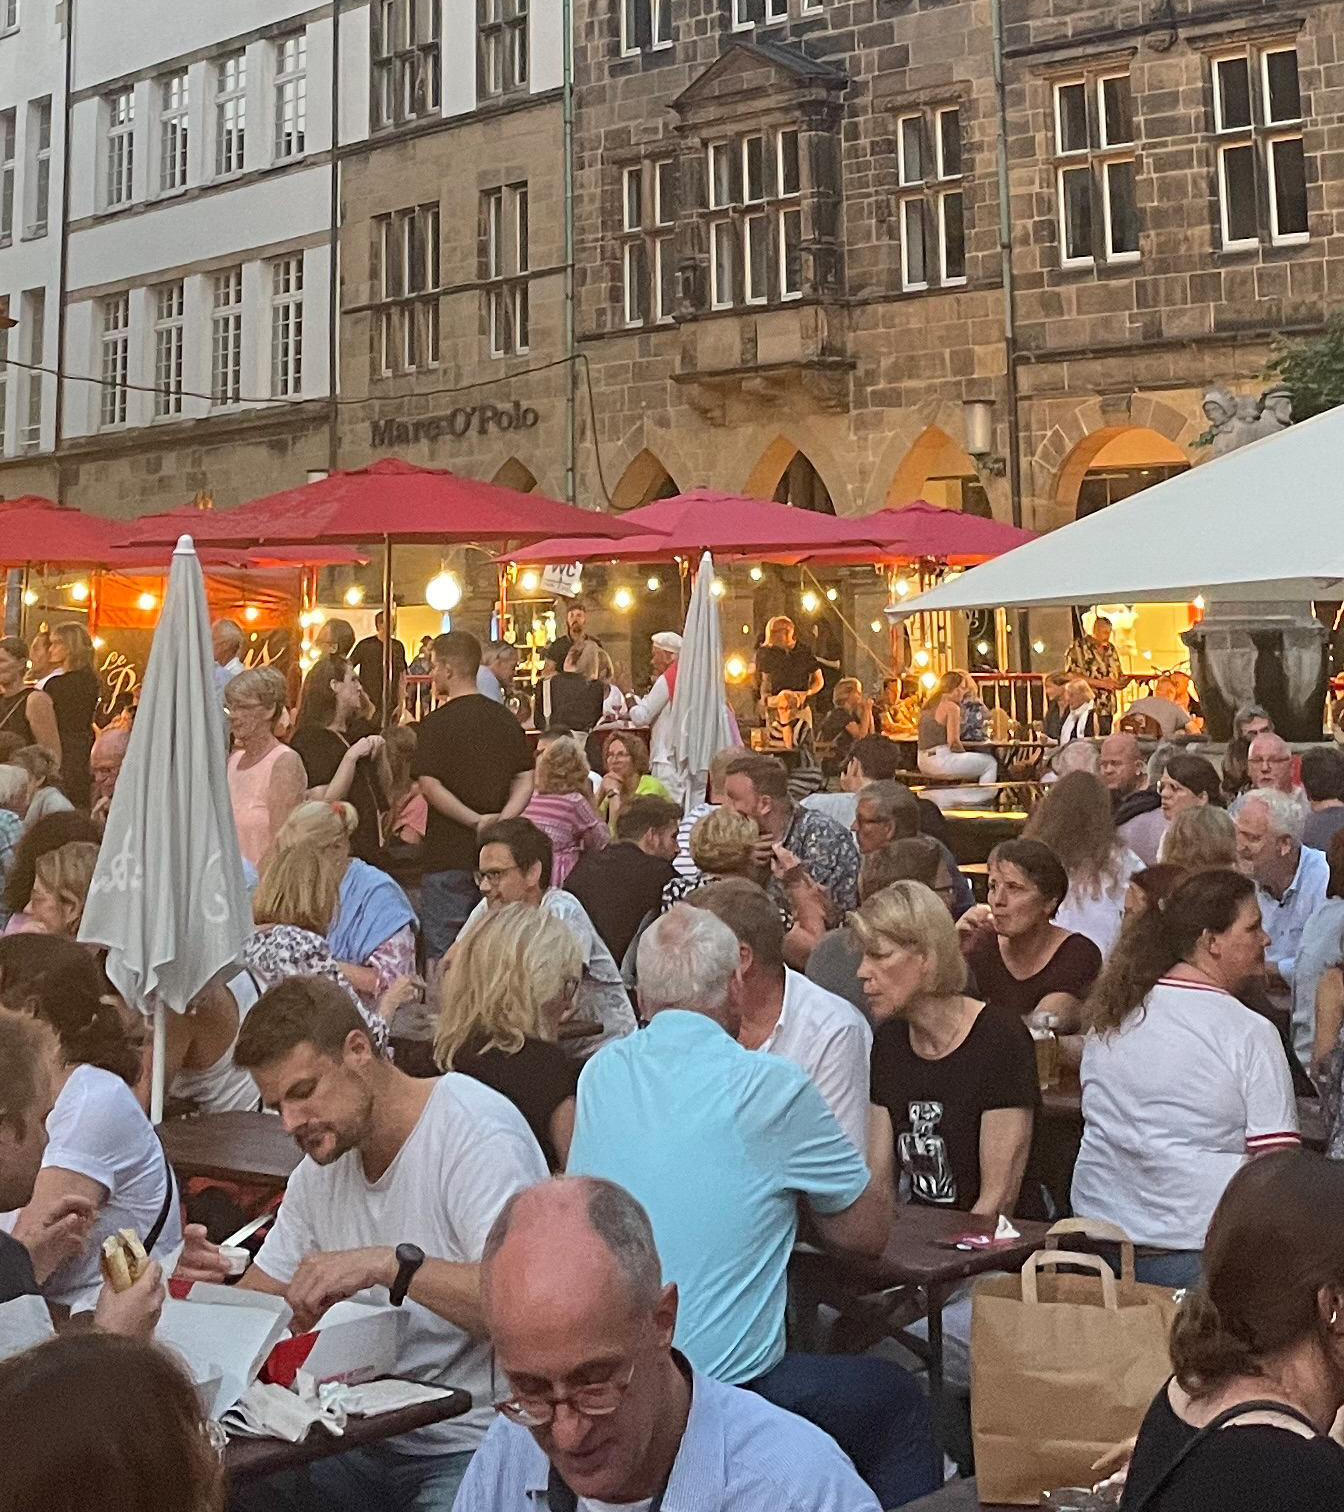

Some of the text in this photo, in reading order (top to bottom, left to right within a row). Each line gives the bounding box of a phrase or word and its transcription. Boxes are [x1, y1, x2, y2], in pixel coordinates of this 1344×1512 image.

[369, 416, 441, 448] Marc
[552, 564, 577, 577] WC
[100, 651, 128, 671] Le
